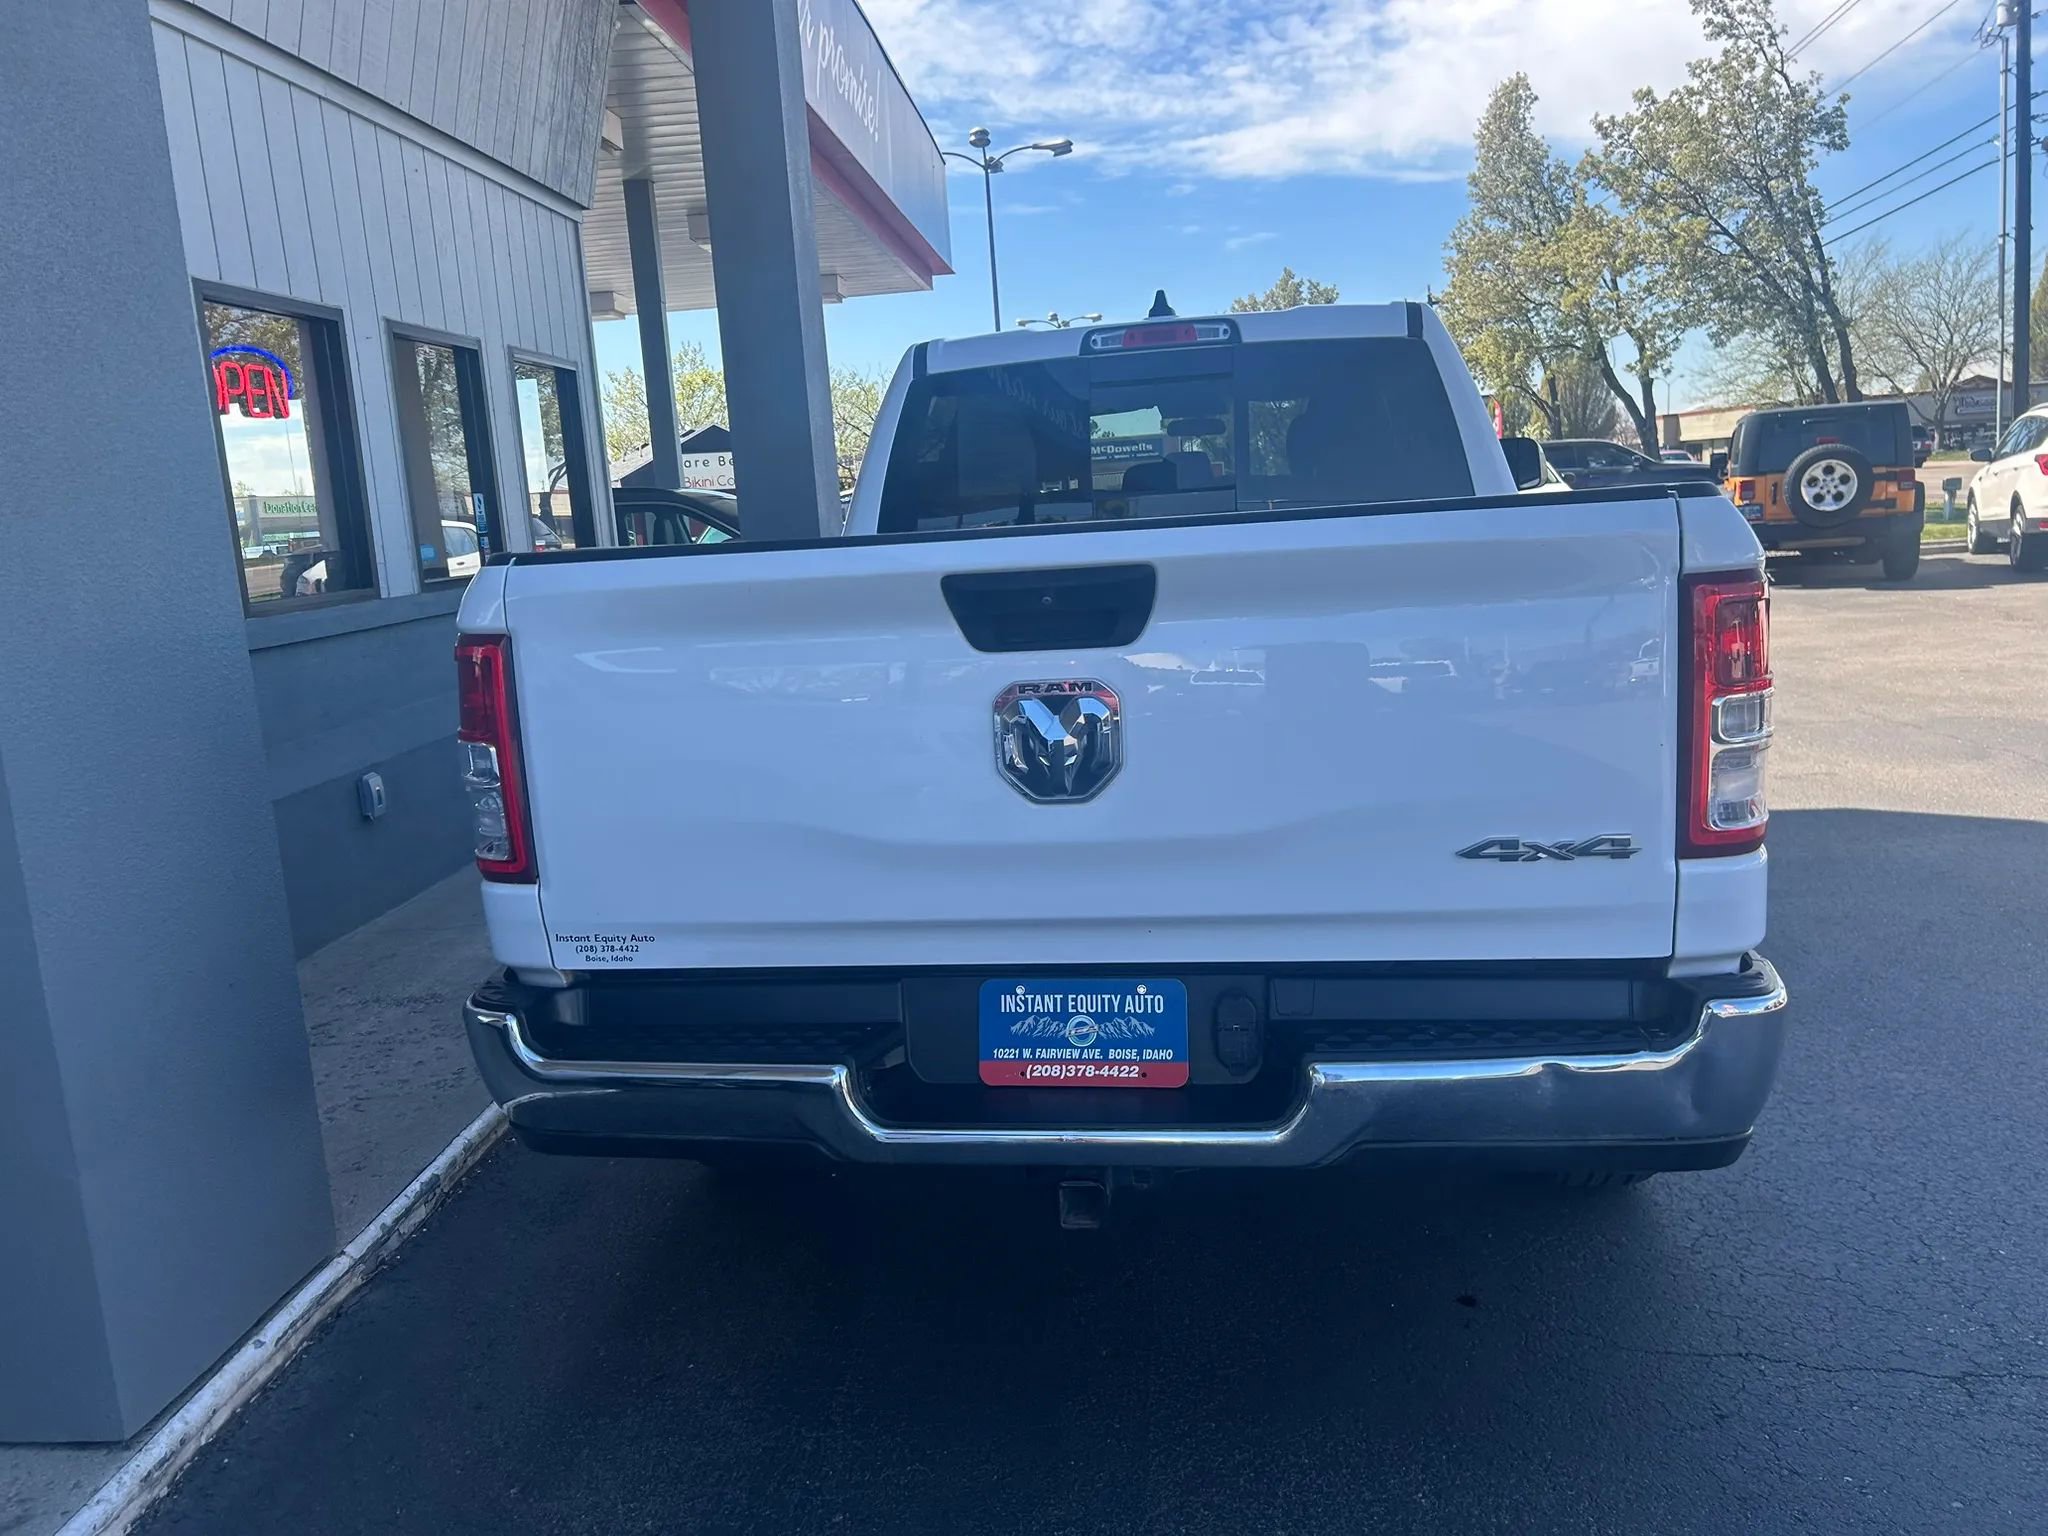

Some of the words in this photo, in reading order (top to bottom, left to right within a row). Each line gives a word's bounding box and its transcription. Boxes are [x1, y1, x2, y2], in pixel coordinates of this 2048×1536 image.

[816, 19, 881, 143] promise!
[212, 361, 291, 419] PEN
[1090, 443, 1153, 455] McDowells
[683, 459, 710, 468] are
[684, 476, 715, 488] Bikini
[263, 501, 301, 514] Donation
[1017, 682, 1093, 695] RAM
[1455, 833, 1643, 862] 4x4
[555, 933, 591, 943] Instant
[594, 934, 627, 944] Equity
[630, 934, 656, 943] Auto
[575, 945, 598, 954] (208)
[601, 945, 639, 953] 378-4422
[585, 955, 609, 963] Boise,
[1000, 994, 1063, 1013] INSTANT
[1068, 994, 1121, 1014] EQUITY
[1124, 994, 1164, 1014] AUTO
[993, 1048, 1019, 1059] 10221
[1022, 1049, 1033, 1059] W.
[1035, 1049, 1082, 1060] FAIRVIEW
[1082, 1049, 1103, 1060] AVE.
[1108, 1049, 1140, 1062] BOISE,
[1142, 1049, 1174, 1060] IDAHO
[1026, 1065, 1140, 1079] (208)378-4422
